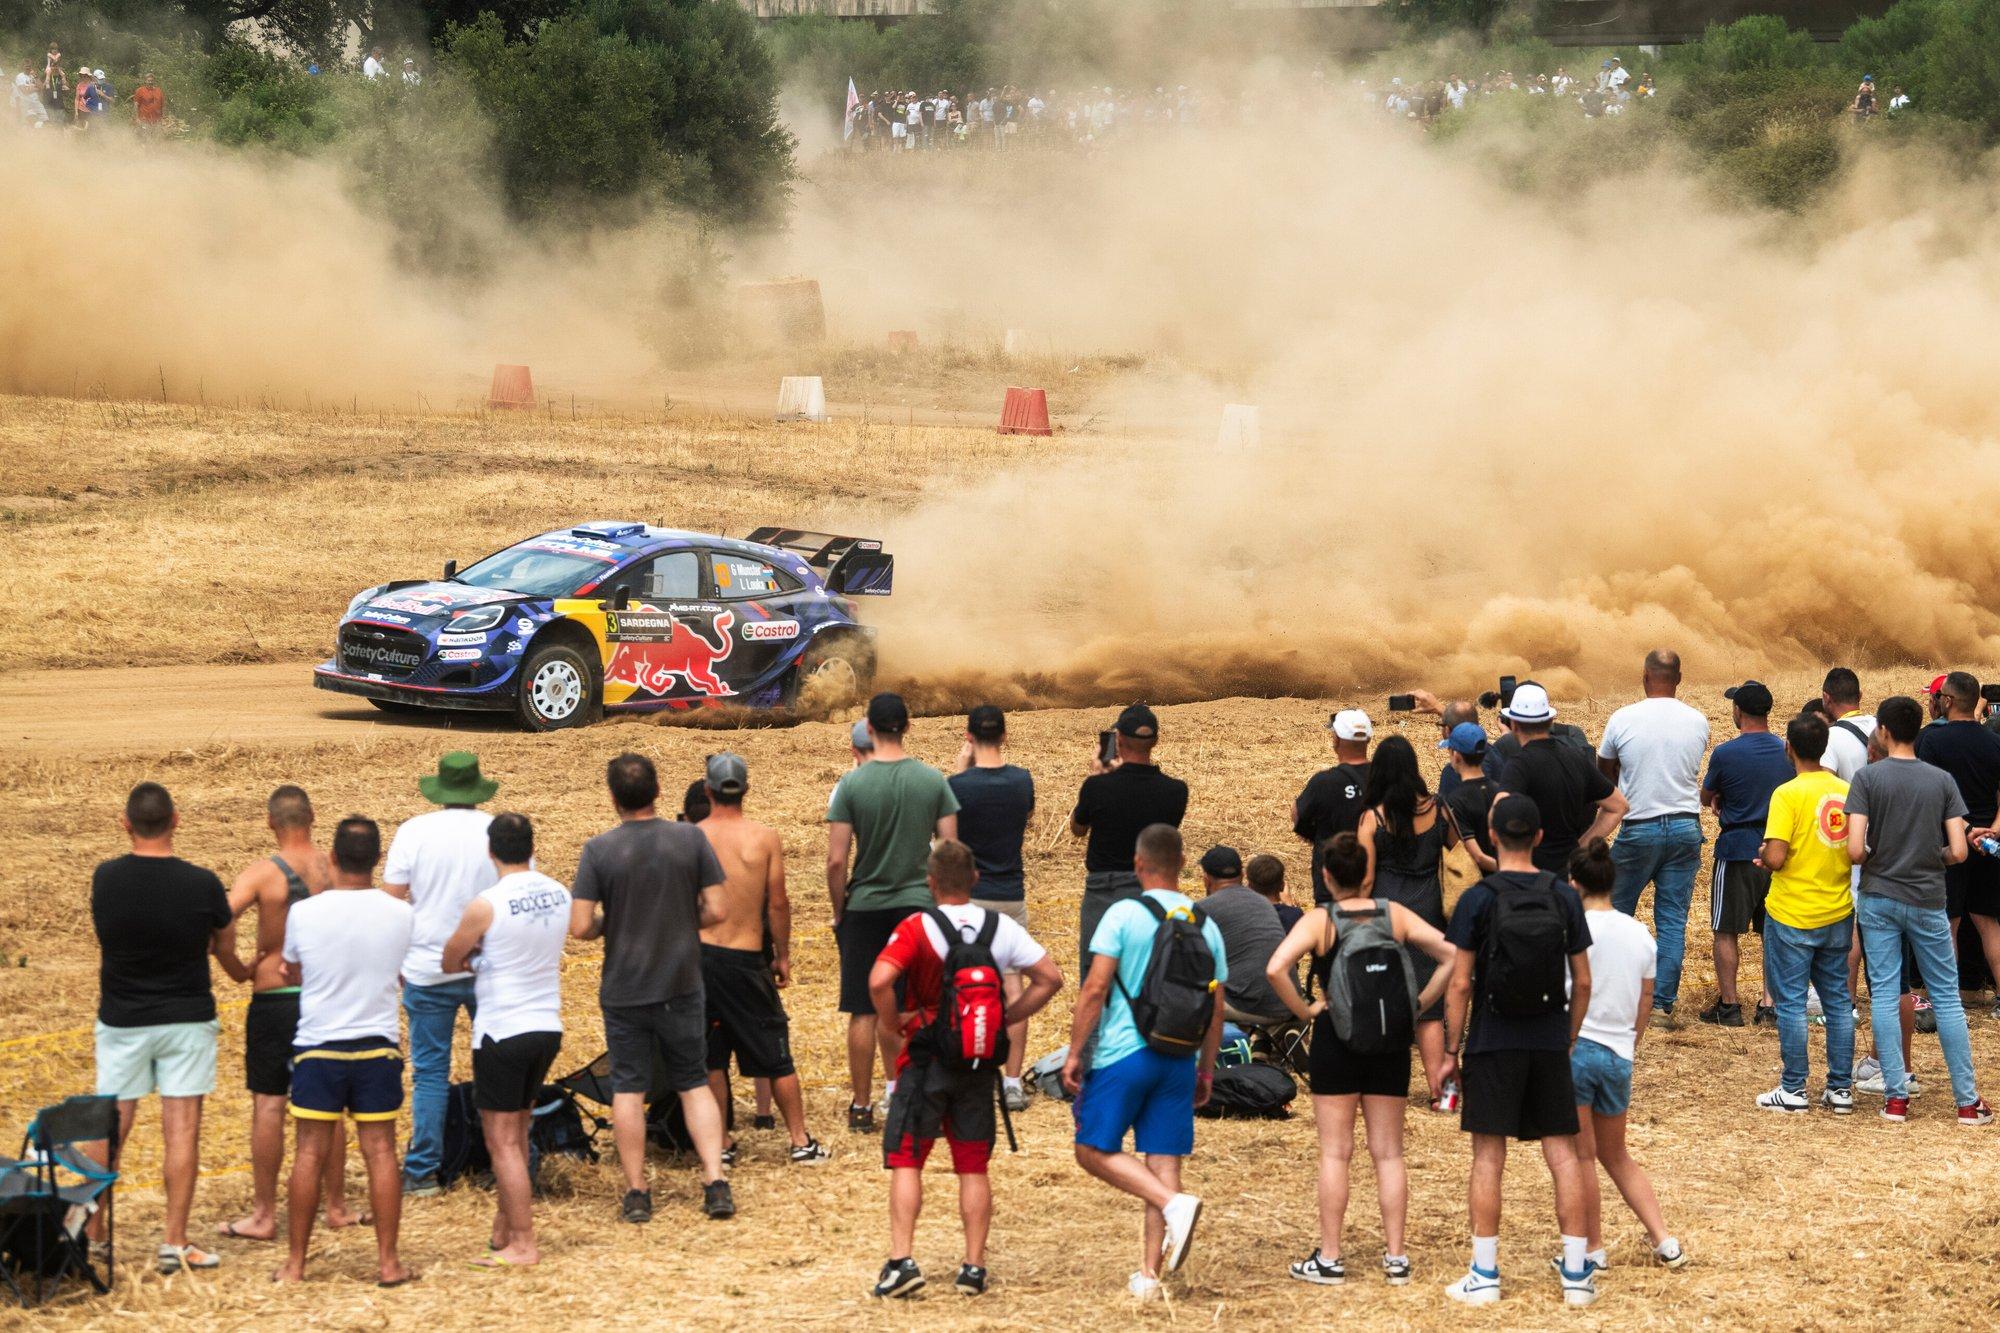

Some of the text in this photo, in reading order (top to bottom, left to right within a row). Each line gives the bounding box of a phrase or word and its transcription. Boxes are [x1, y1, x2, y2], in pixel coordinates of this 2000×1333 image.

[730, 564, 737, 576] G
[740, 578, 745, 590] L
[620, 618, 671, 628] SARDEGNA
[755, 623, 797, 638] Castrol
[343, 642, 420, 666] SafetyCulture
[447, 649, 480, 659] Castrol
[509, 891, 567, 915] BOXEUR
